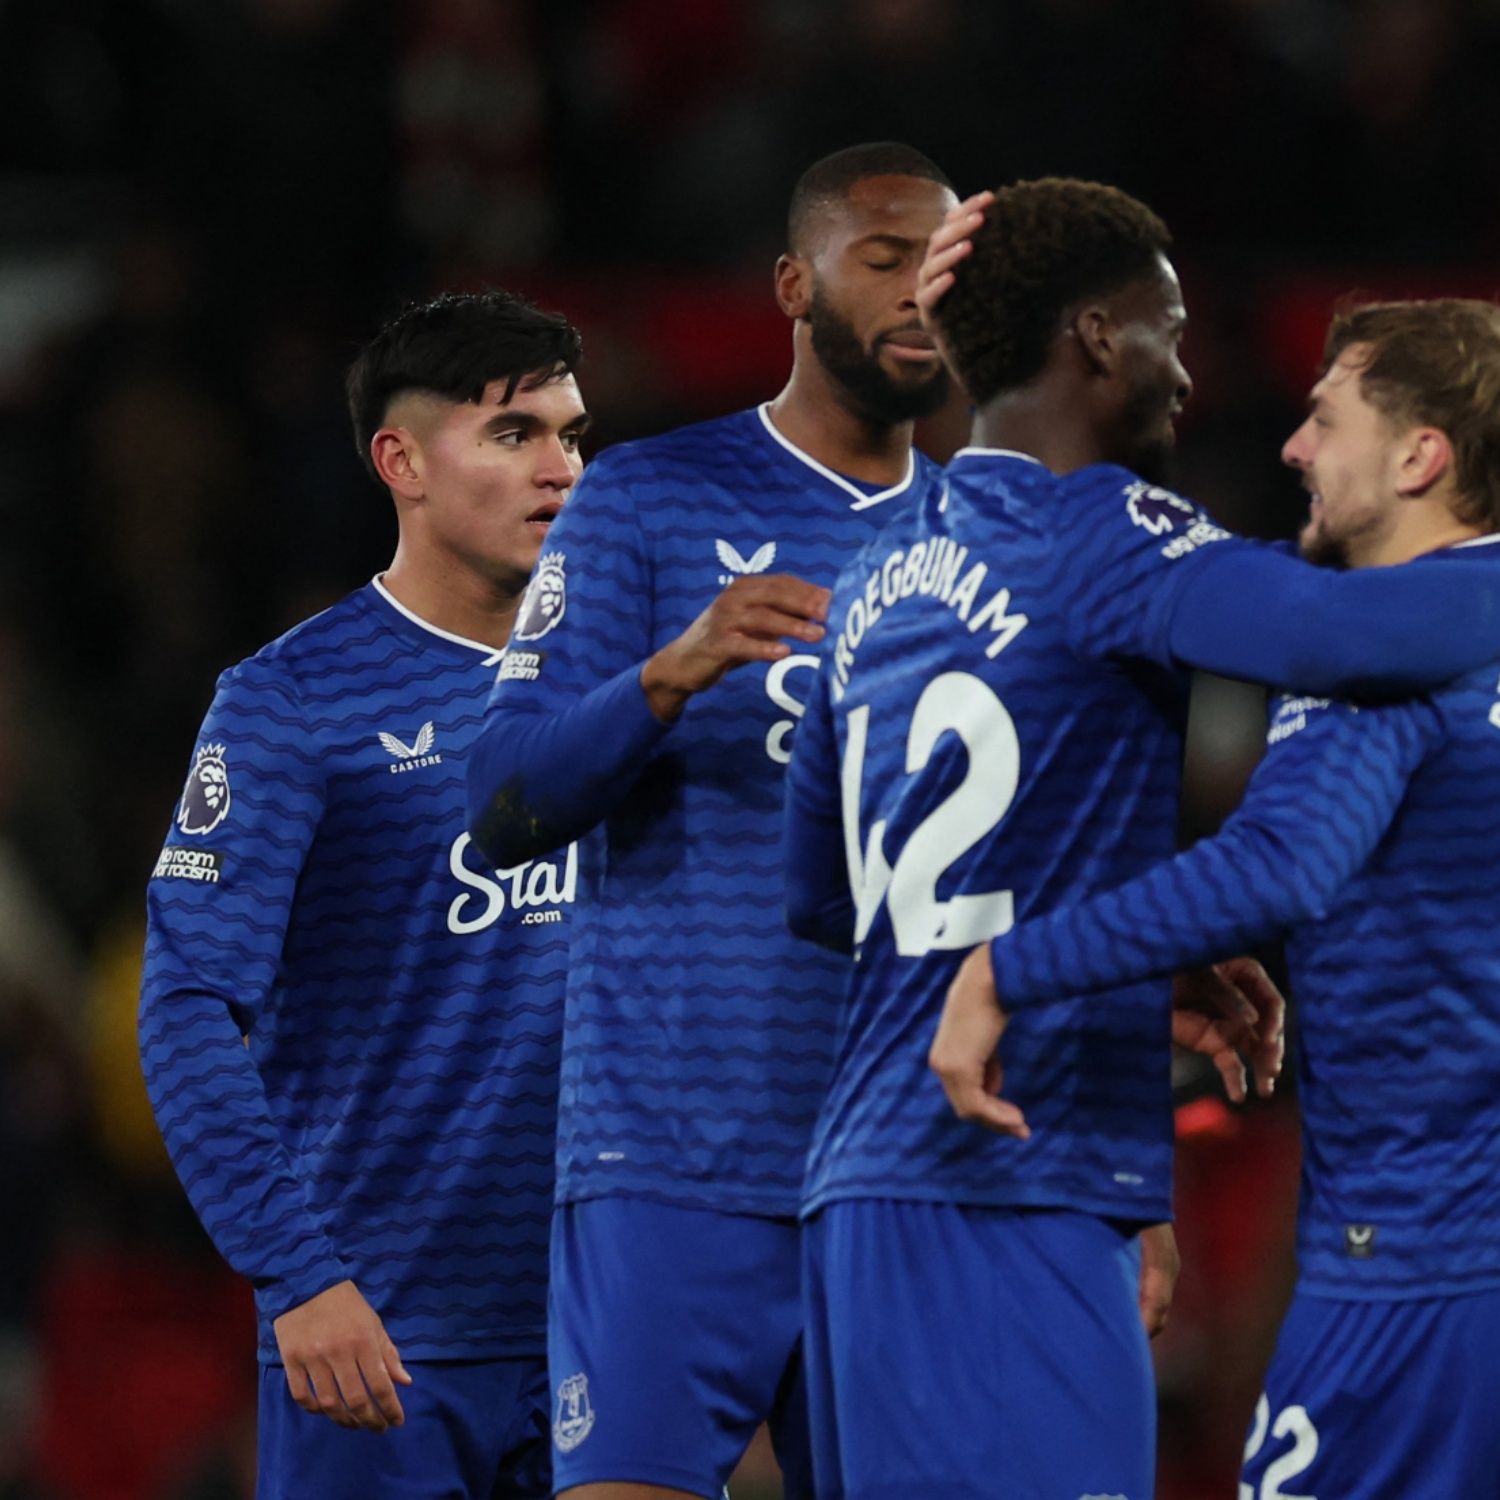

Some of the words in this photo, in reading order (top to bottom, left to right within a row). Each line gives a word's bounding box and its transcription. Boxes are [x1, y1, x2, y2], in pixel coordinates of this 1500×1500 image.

[390, 754, 442, 774] CASTORE
[841, 671, 1020, 962] 42
[172, 849, 215, 868] room
[167, 864, 219, 883] racism
[521, 910, 561, 925] .com
